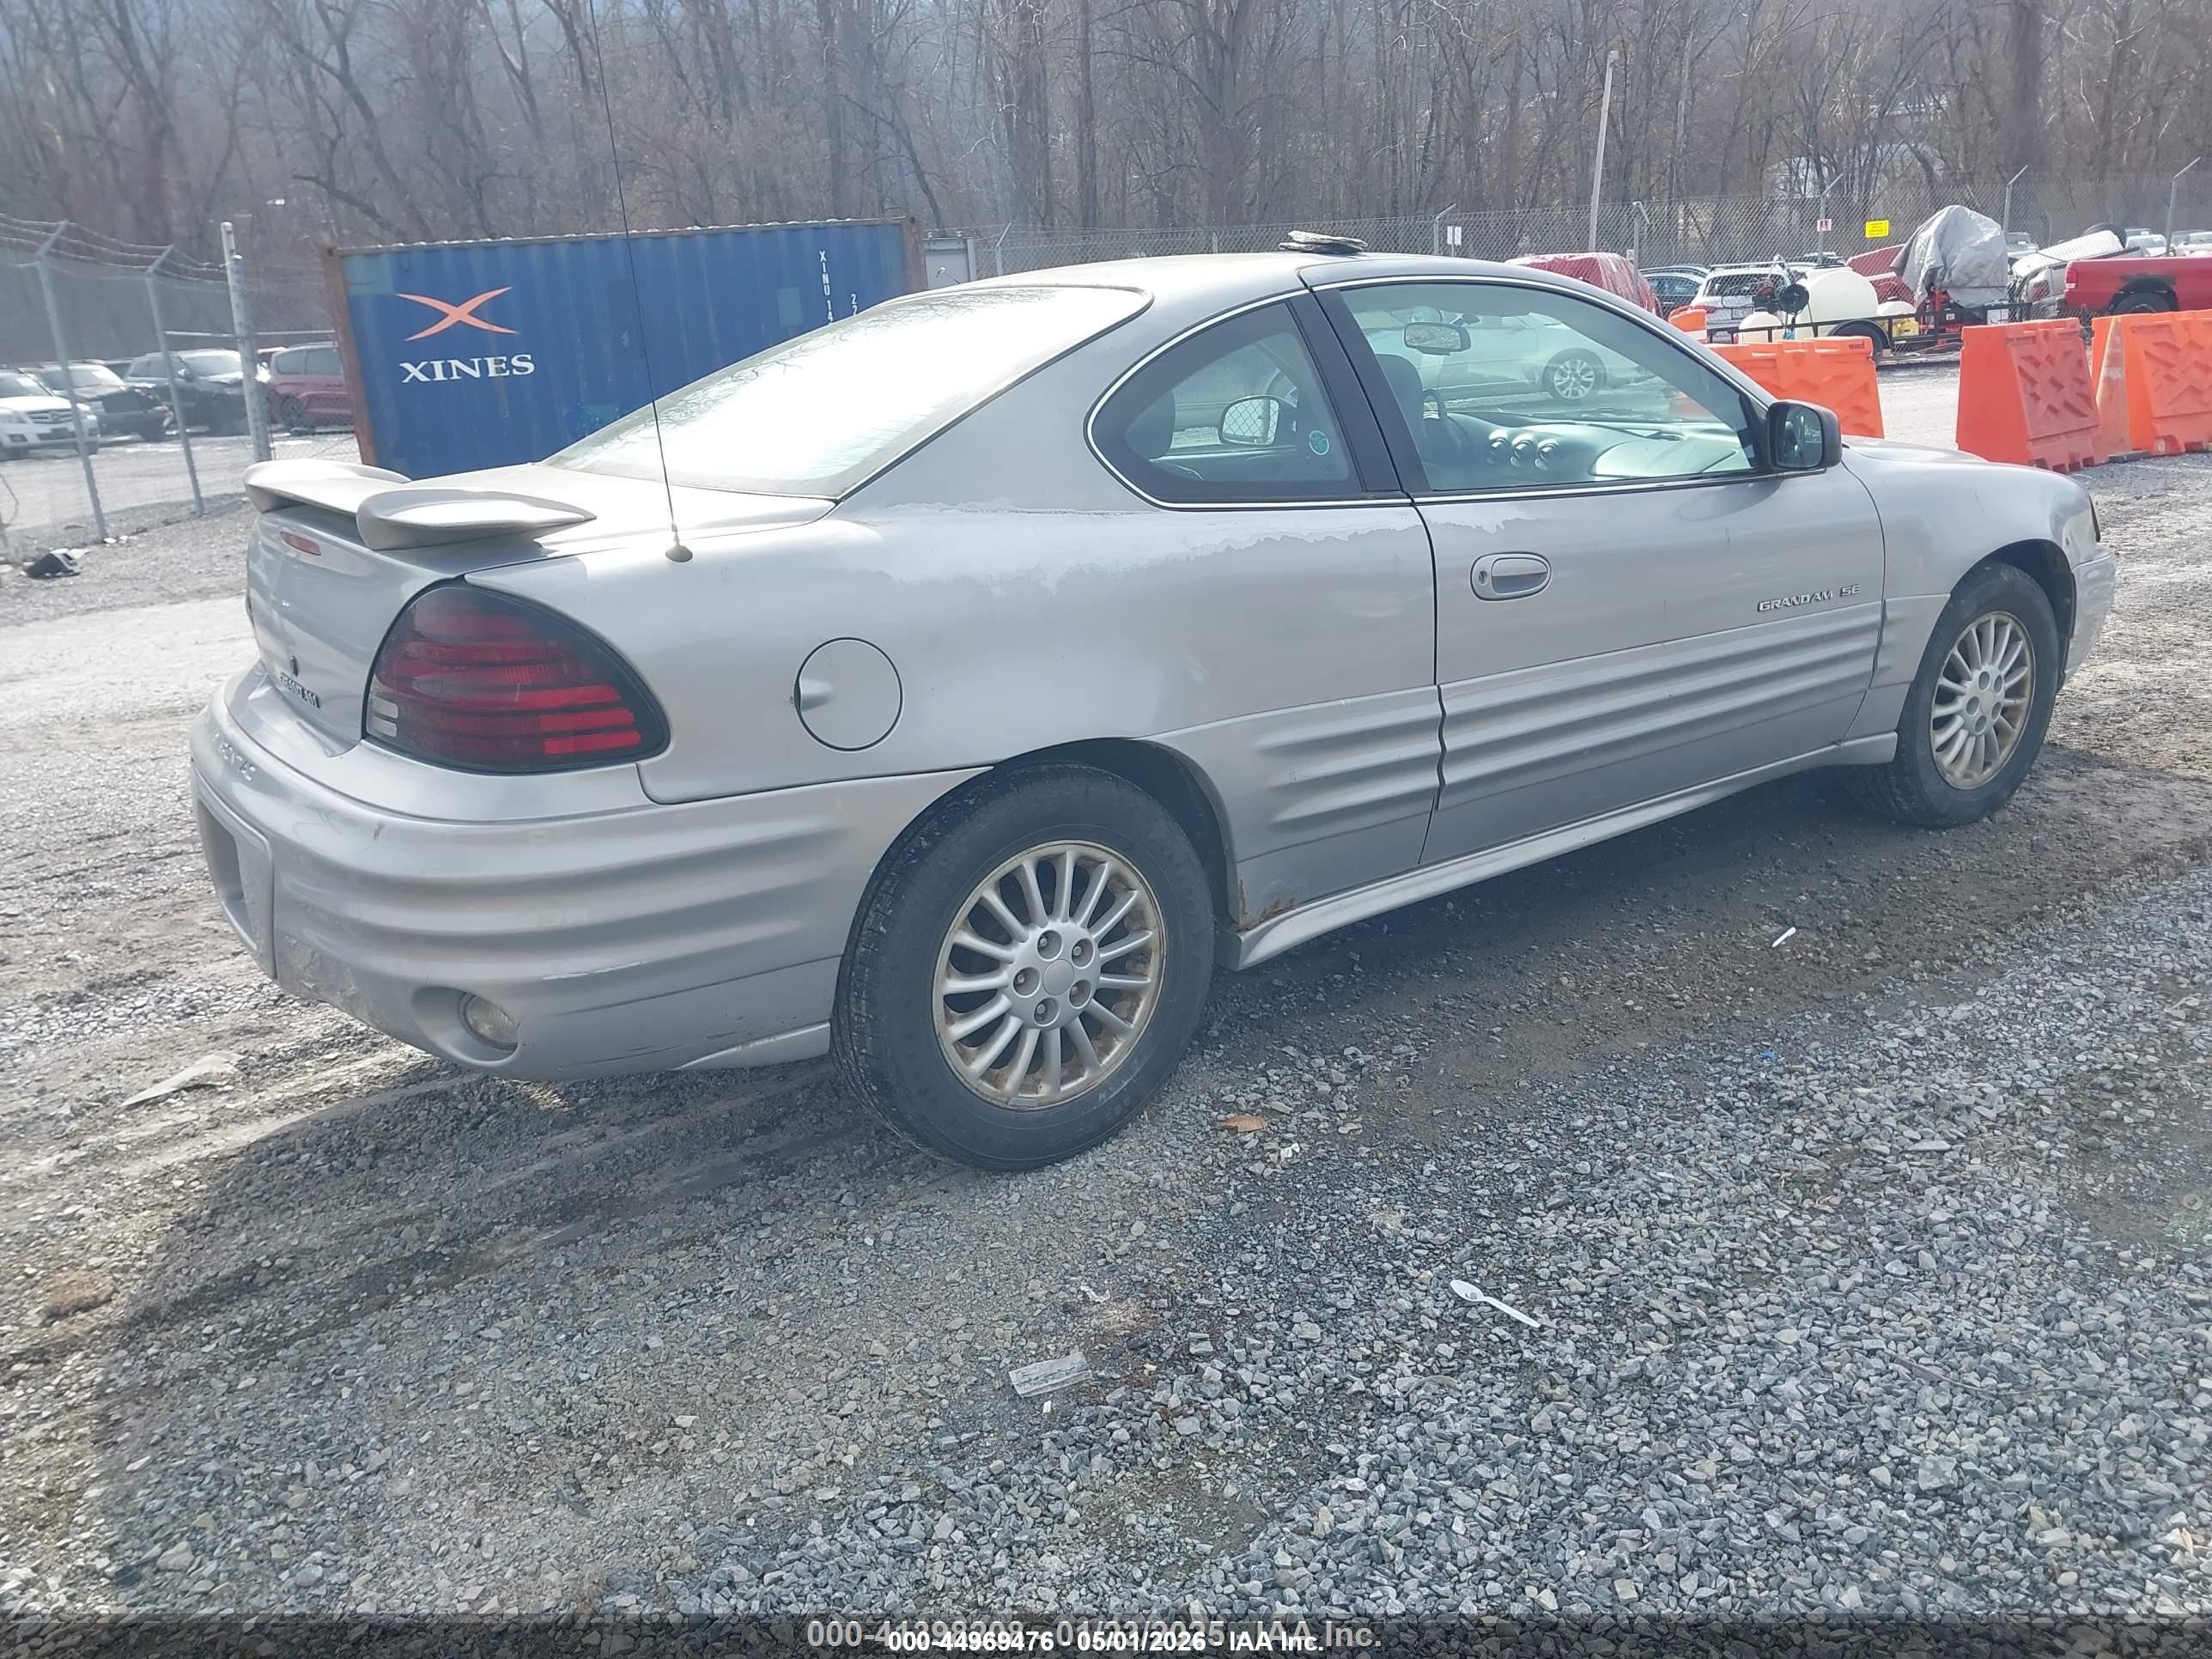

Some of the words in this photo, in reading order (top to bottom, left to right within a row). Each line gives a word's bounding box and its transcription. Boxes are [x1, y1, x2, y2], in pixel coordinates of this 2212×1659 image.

[819, 250, 830, 295] XINU
[399, 354, 535, 383] XINES
[1839, 584, 1861, 597] SE
